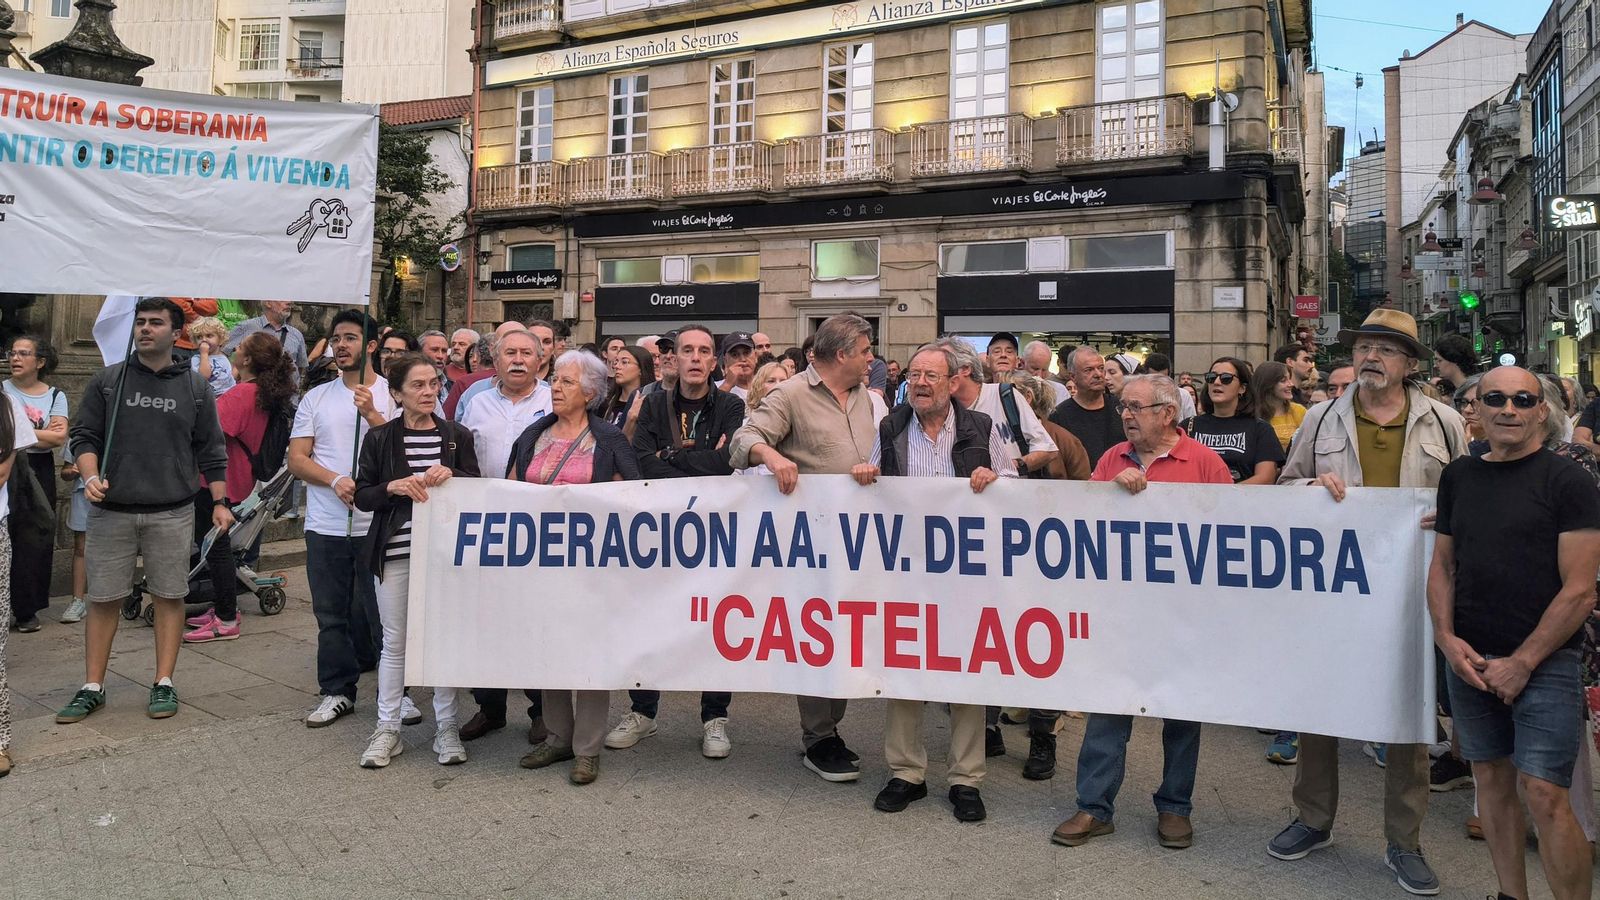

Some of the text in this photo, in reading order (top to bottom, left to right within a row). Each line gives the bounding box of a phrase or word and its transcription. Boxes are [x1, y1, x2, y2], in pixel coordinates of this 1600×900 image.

[867, 1, 933, 22] Alianza
[561, 30, 739, 68] Alianza Española Seguros
[89, 101, 109, 128] A
[115, 102, 269, 143] SOBERANÍA
[72, 139, 94, 169] O
[100, 142, 216, 178] DEREITO
[220, 145, 238, 180] Á
[247, 153, 350, 190] VIVENDA
[992, 195, 1030, 205] VIAJES
[1033, 191, 1044, 202] El
[1044, 190, 1069, 201] Corte
[1070, 185, 1107, 204] Inglés
[652, 218, 680, 227] VIAJES
[689, 215, 707, 225] Corte
[707, 212, 734, 227] Inglés
[650, 293, 695, 308] Orange
[1296, 302, 1318, 310] GAES
[126, 392, 177, 412] Jeep
[1194, 431, 1246, 450] ANTIFEIXISTA
[453, 496, 1371, 595] FEDERACIÓN AA. VV. DE PONTEVEDRA
[690, 594, 1090, 679] "CASTELAO"
